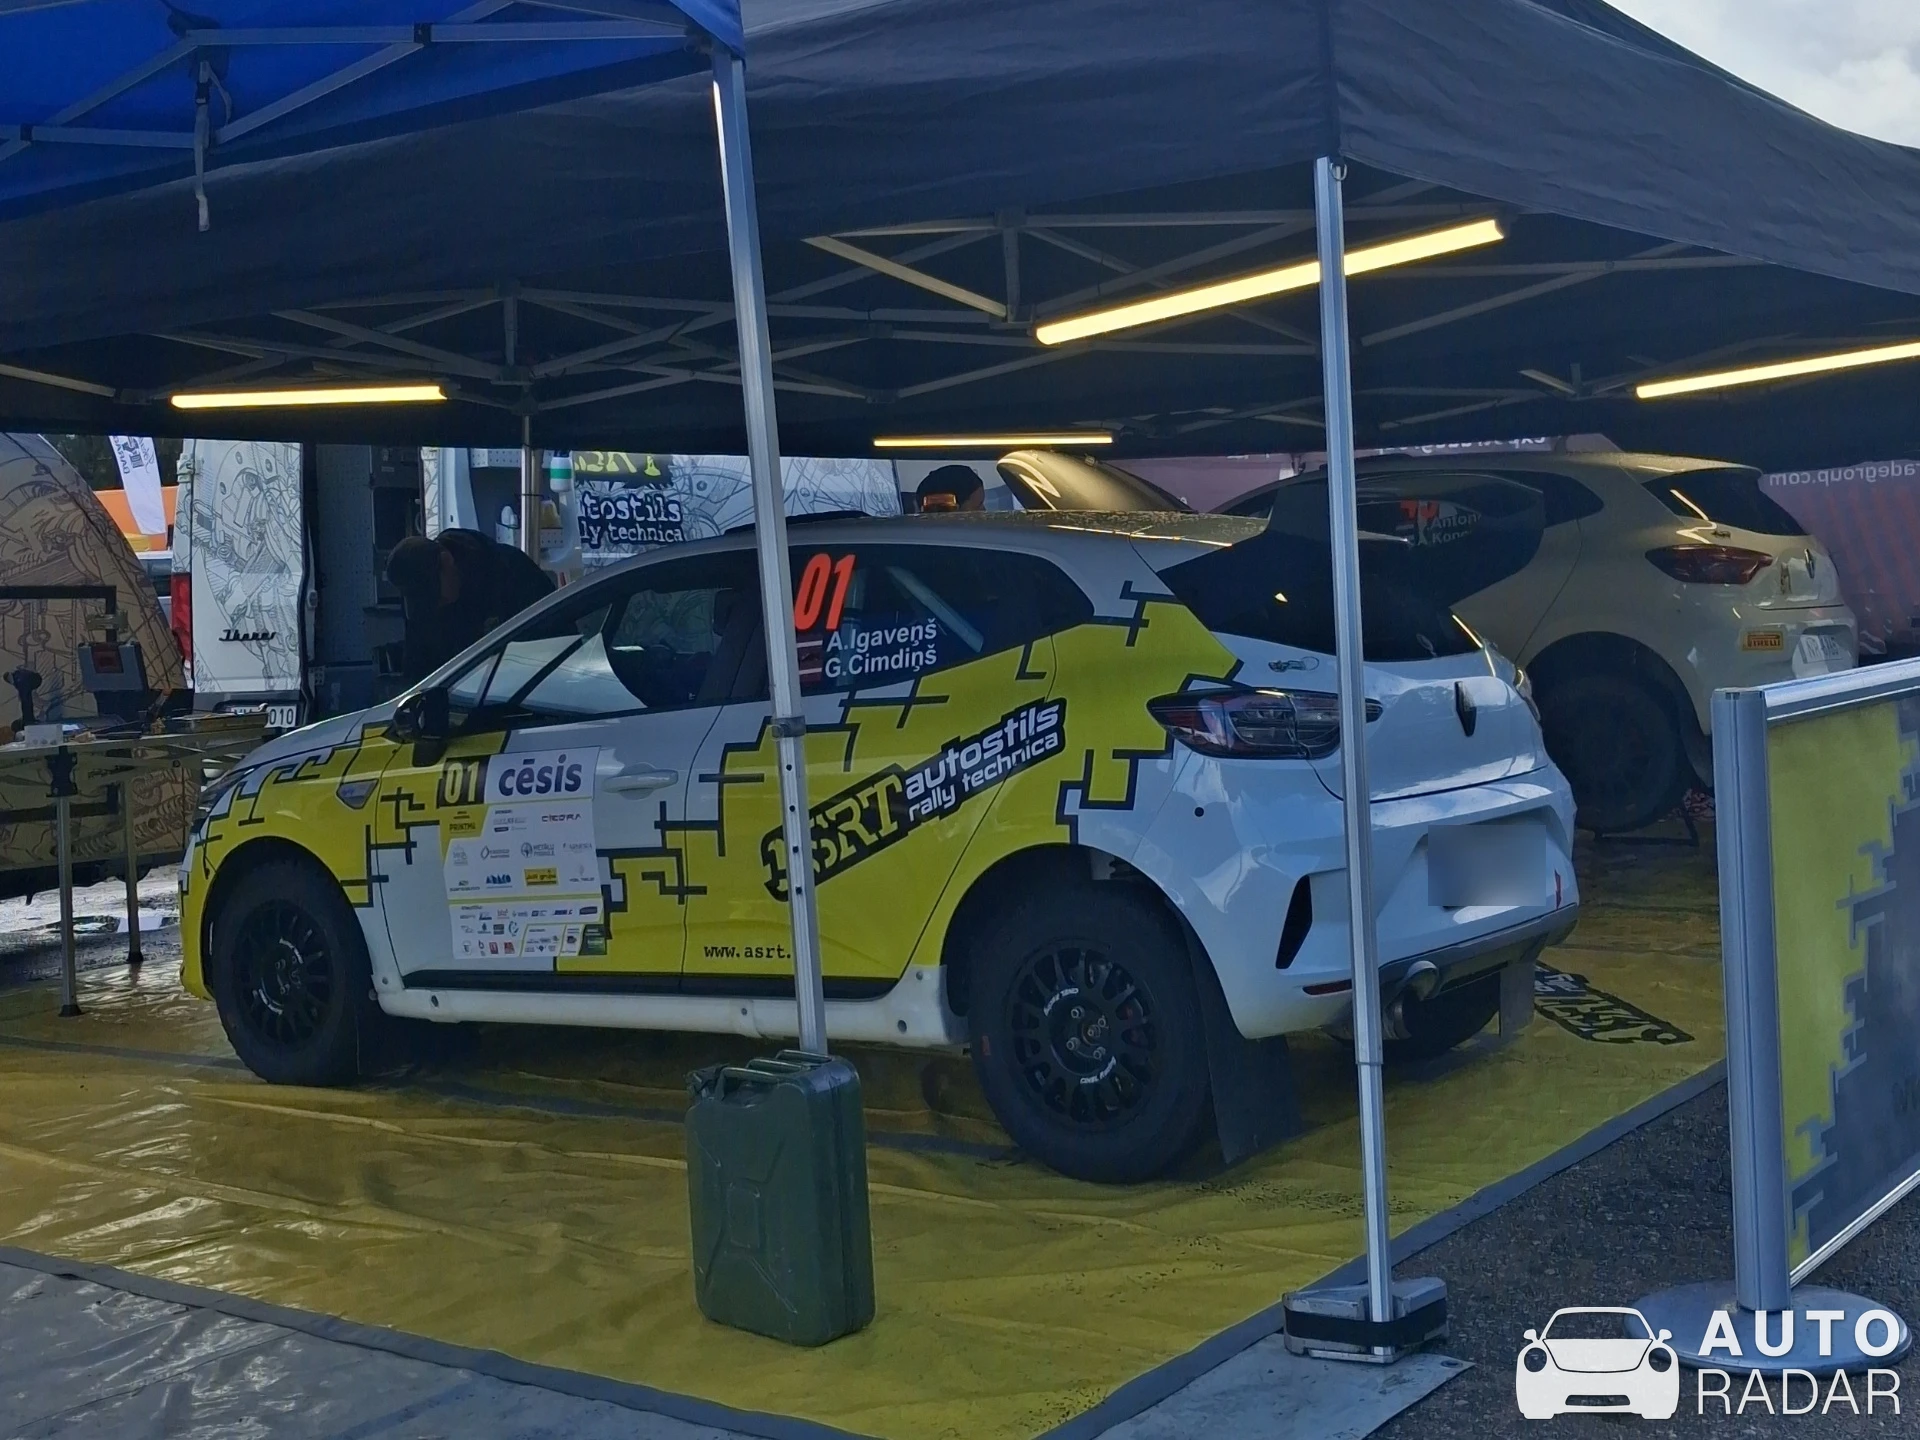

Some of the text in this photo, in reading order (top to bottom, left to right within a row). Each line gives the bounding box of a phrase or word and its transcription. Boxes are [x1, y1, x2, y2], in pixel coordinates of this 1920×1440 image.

[608, 522, 684, 543] technica
[793, 552, 857, 631] 01
[826, 618, 938, 654] A.Igaveņš
[824, 645, 938, 679] G.Cimdiņš
[905, 703, 1060, 801] autostils
[908, 731, 1059, 823] rally technica
[444, 753, 582, 804] 01 cēsis
